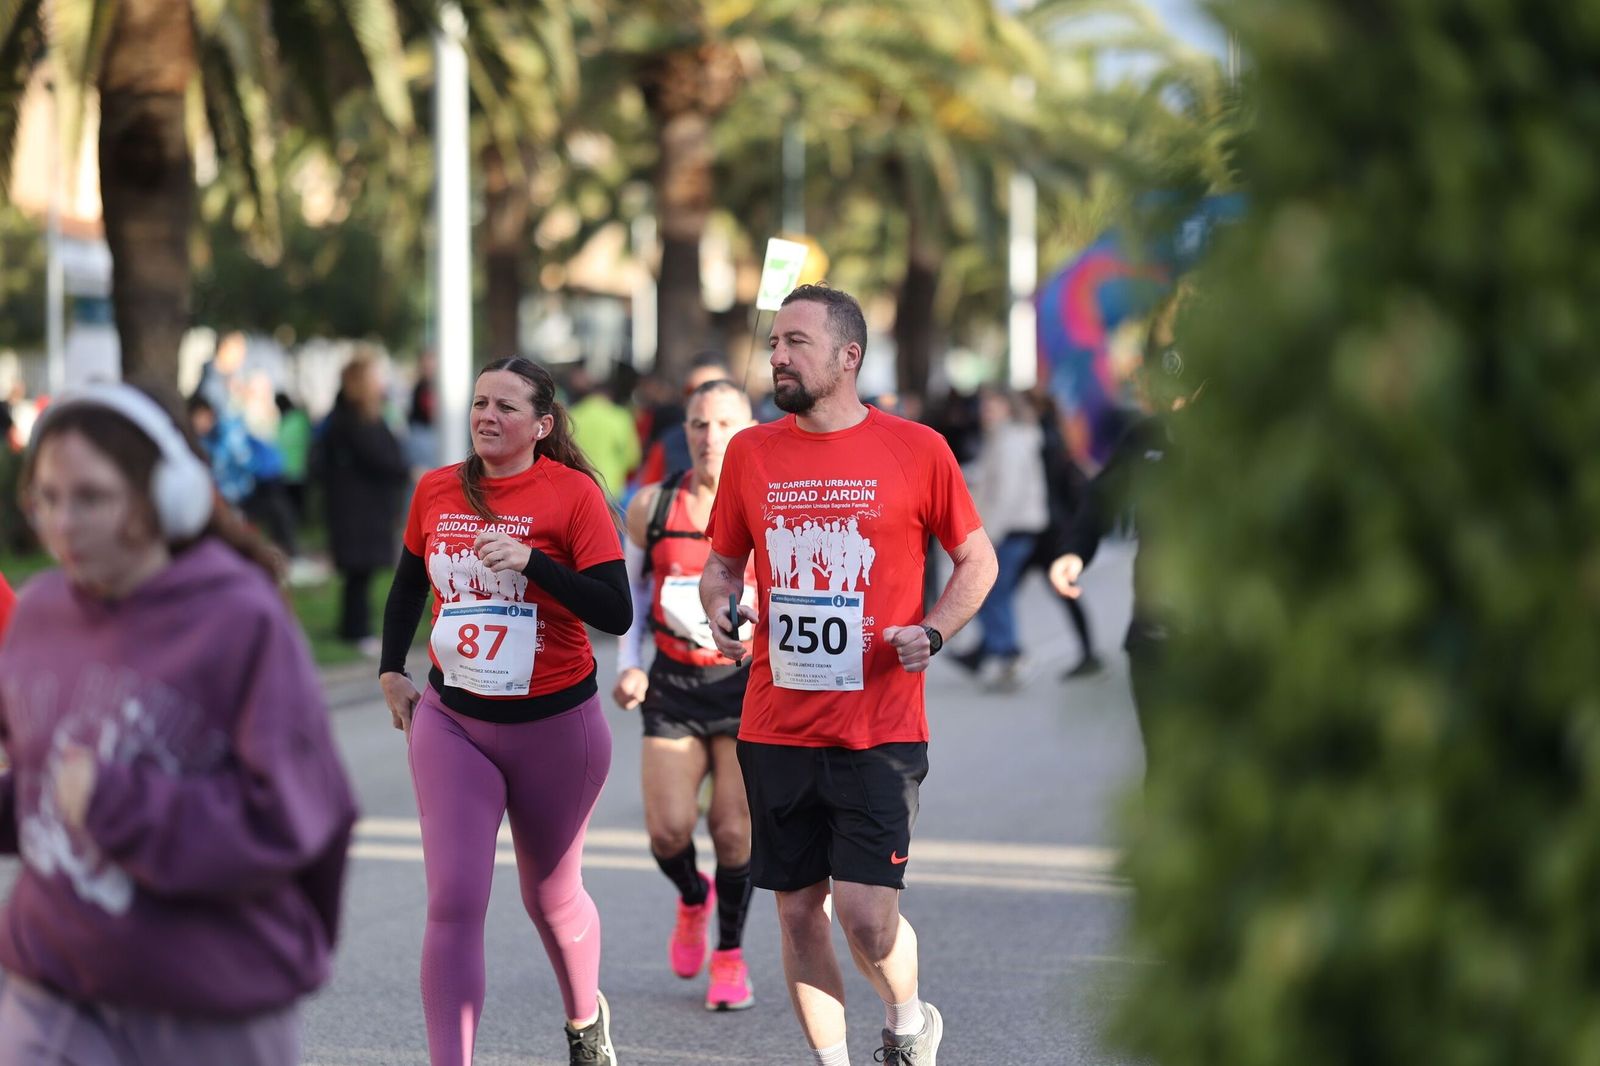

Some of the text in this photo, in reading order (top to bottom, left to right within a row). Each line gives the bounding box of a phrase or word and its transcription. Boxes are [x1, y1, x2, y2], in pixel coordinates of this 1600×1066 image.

[782, 480, 823, 489] CARRERA
[865, 479, 877, 487] DE
[767, 487, 875, 503] CIUDAD JARDÍN
[521, 516, 534, 524] DE
[436, 521, 477, 533] CIUDAD
[480, 522, 530, 536] JARDÍN
[456, 623, 508, 661] 87
[779, 614, 848, 656] 250
